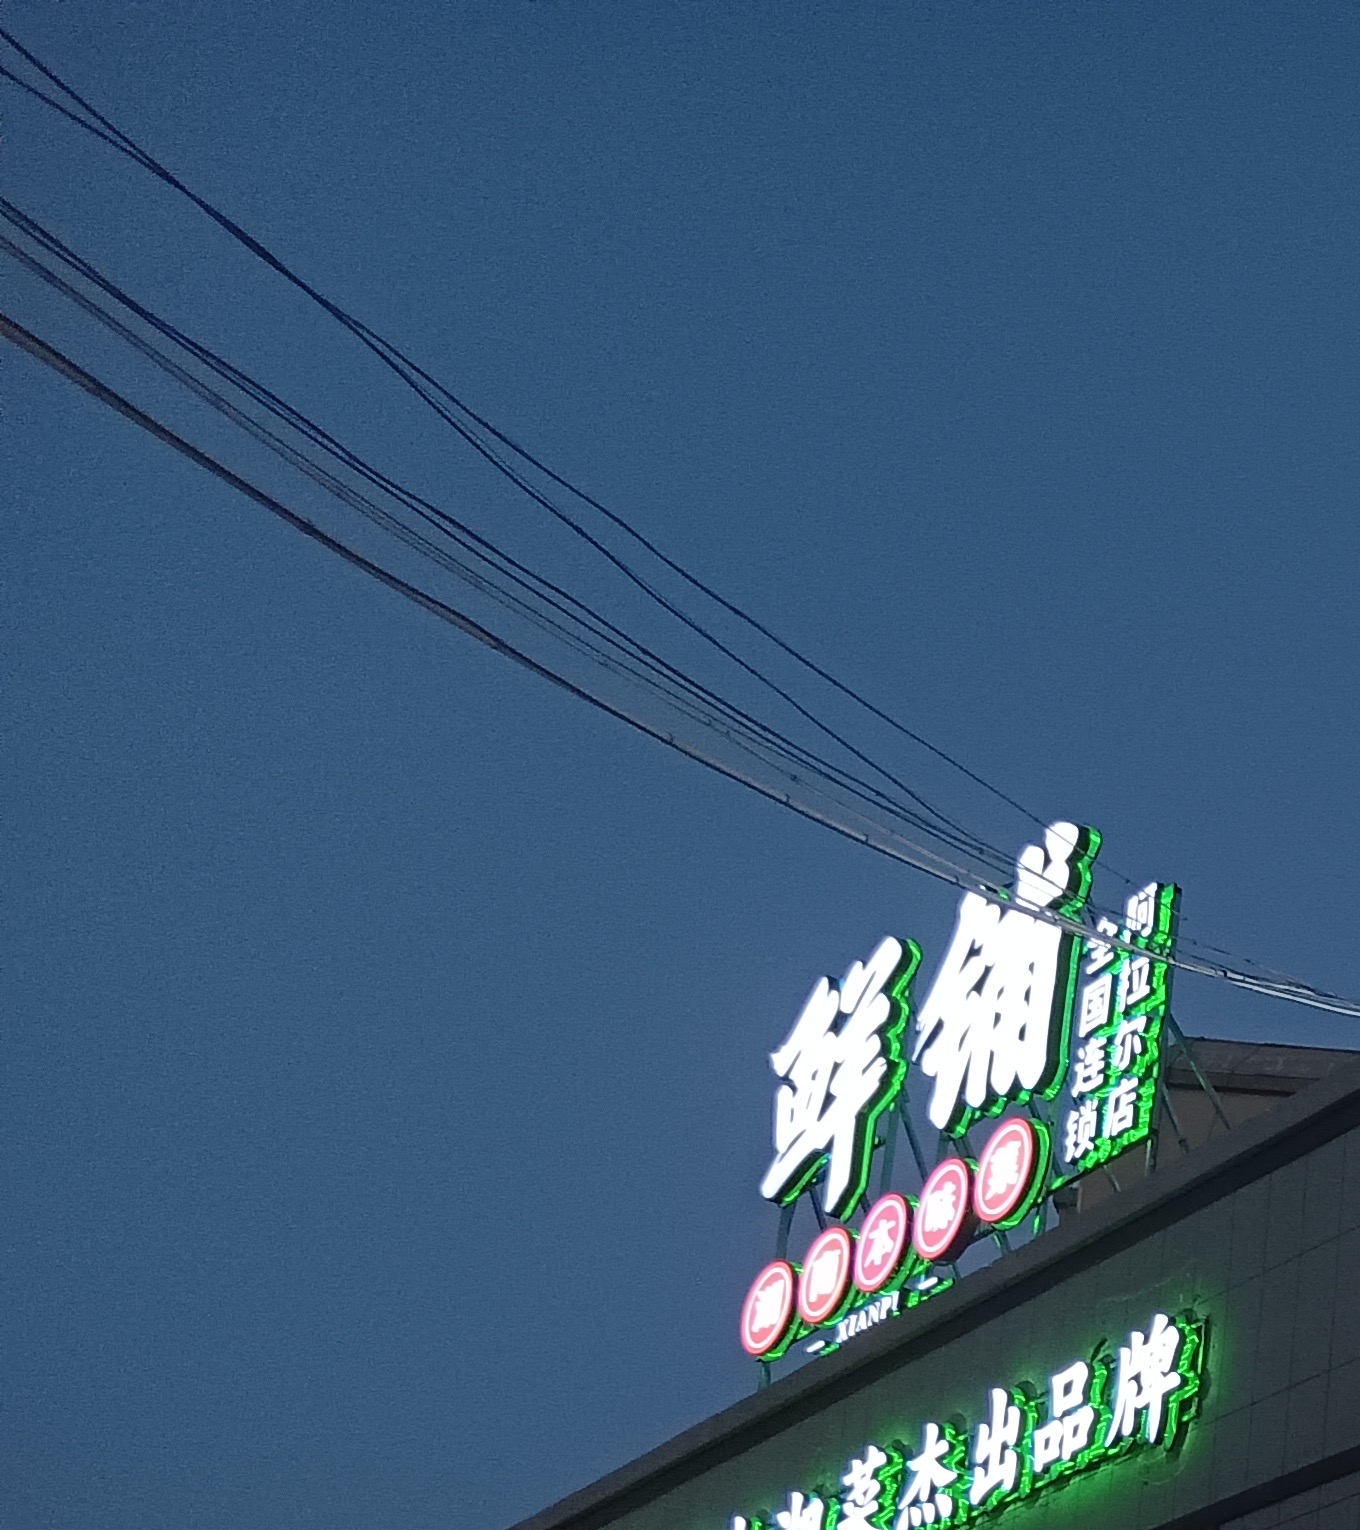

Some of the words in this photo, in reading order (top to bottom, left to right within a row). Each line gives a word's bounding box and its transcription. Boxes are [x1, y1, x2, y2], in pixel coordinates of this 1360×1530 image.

[1065, 917, 1119, 1163] 全国连锁
[1102, 882, 1158, 1139] 阿拉尔店
